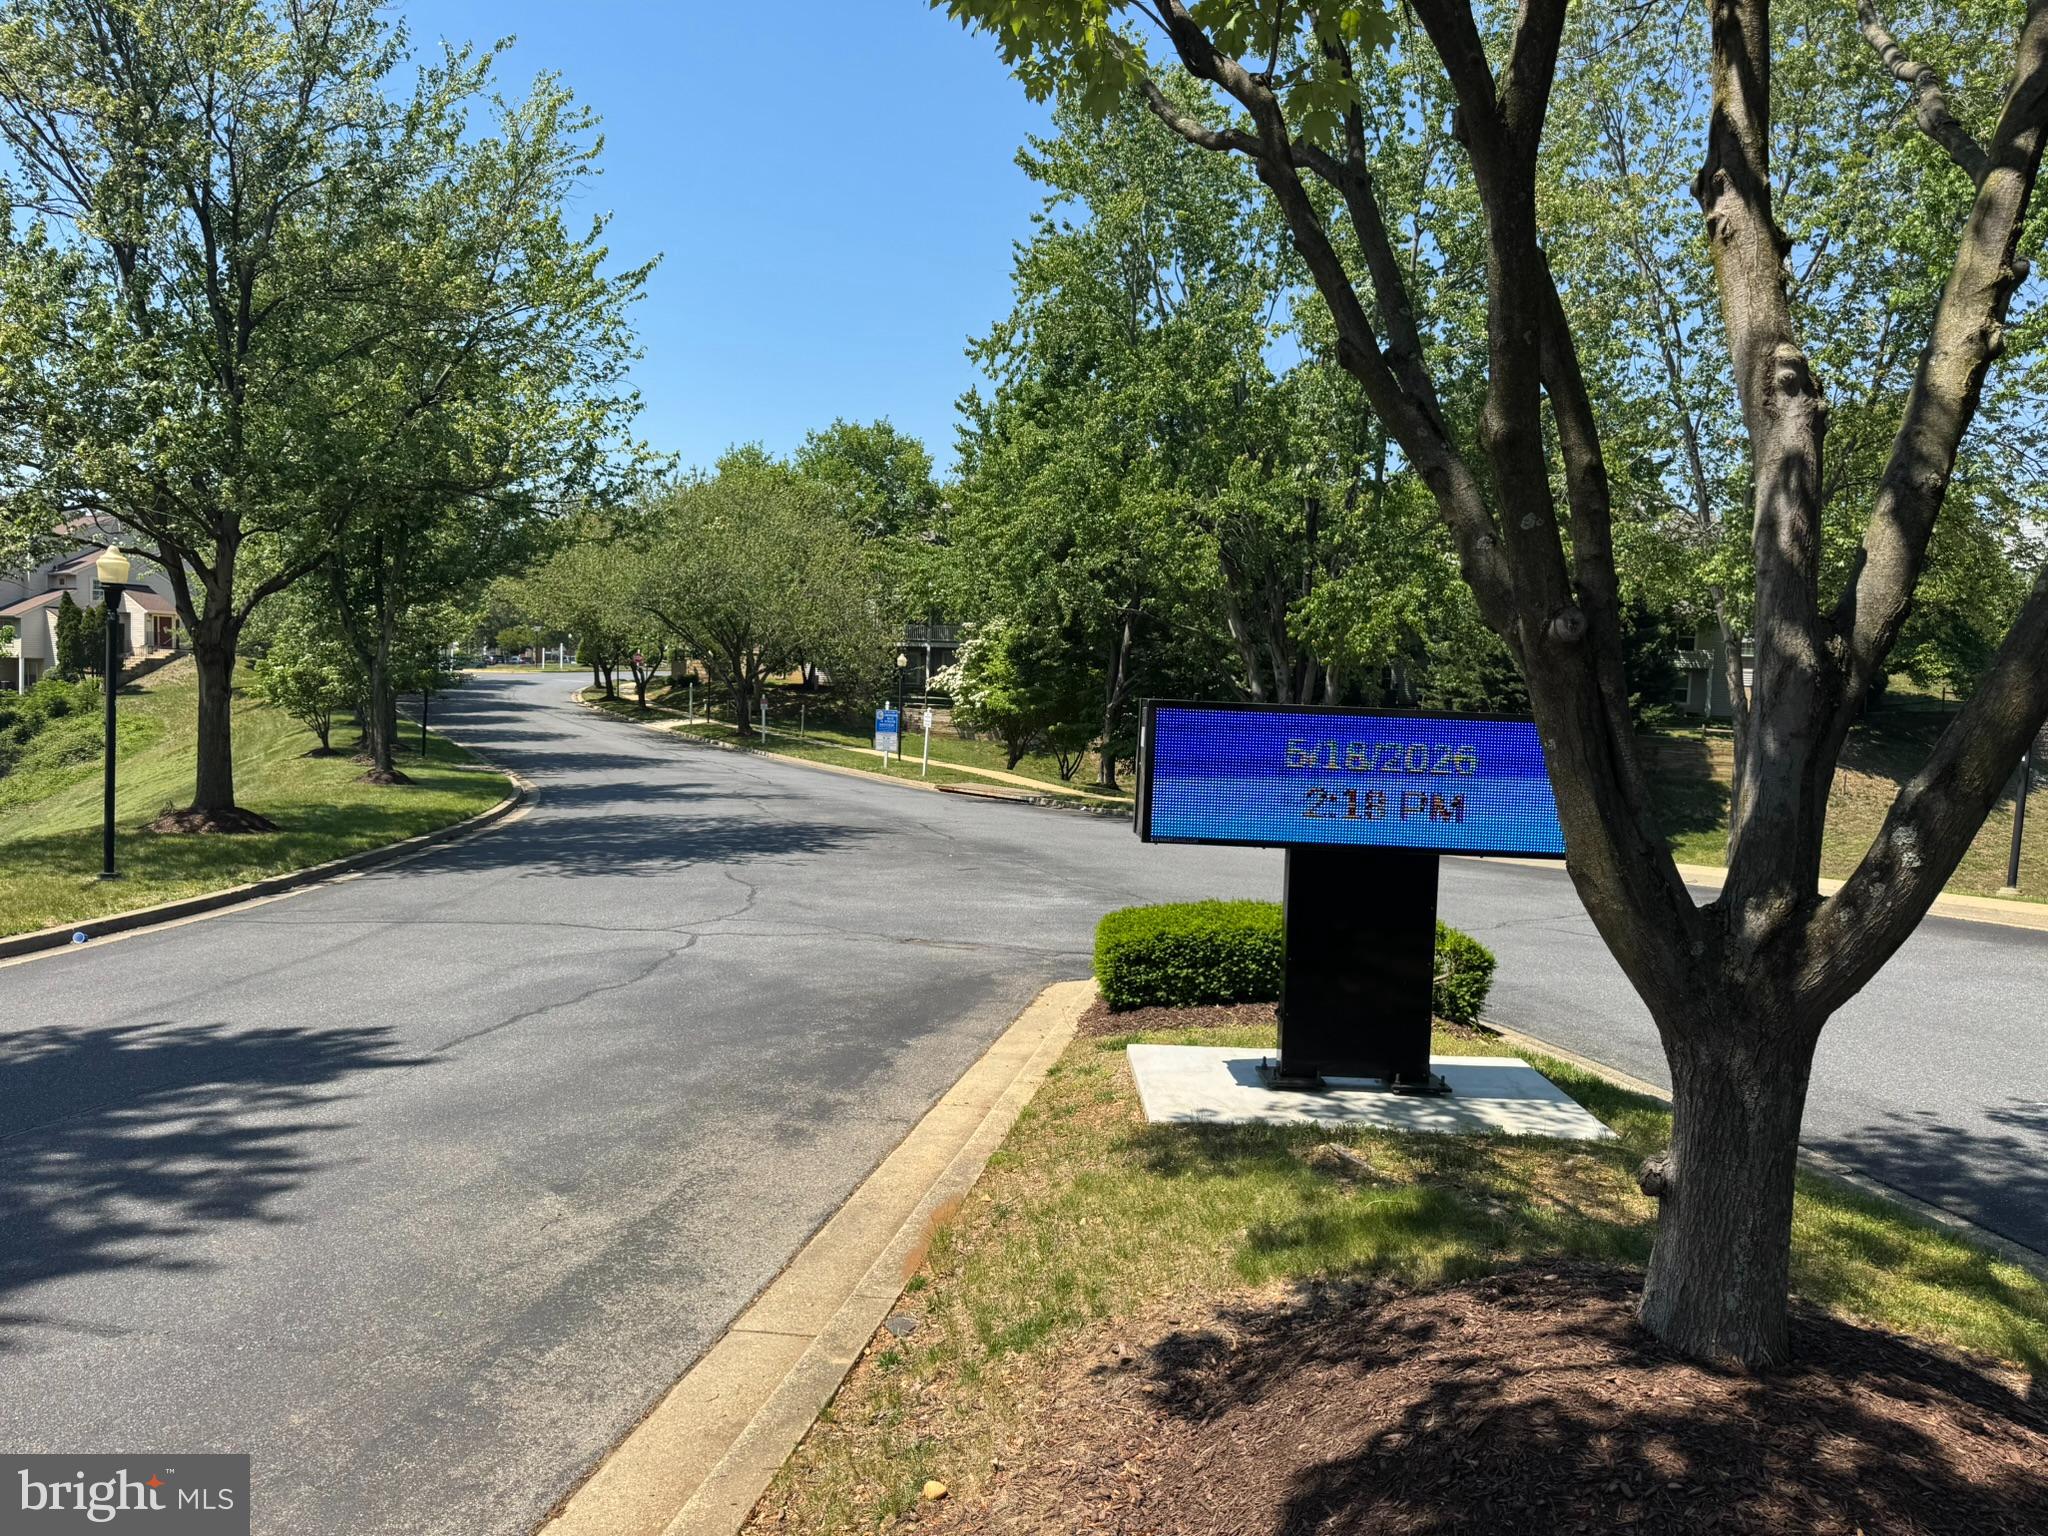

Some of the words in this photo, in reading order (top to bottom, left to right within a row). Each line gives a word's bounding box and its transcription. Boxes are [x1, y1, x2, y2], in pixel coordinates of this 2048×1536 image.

[1286, 738, 1478, 776] 5/18/2026
[1302, 786, 1387, 821] 2:18
[1402, 791, 1465, 824] PM
